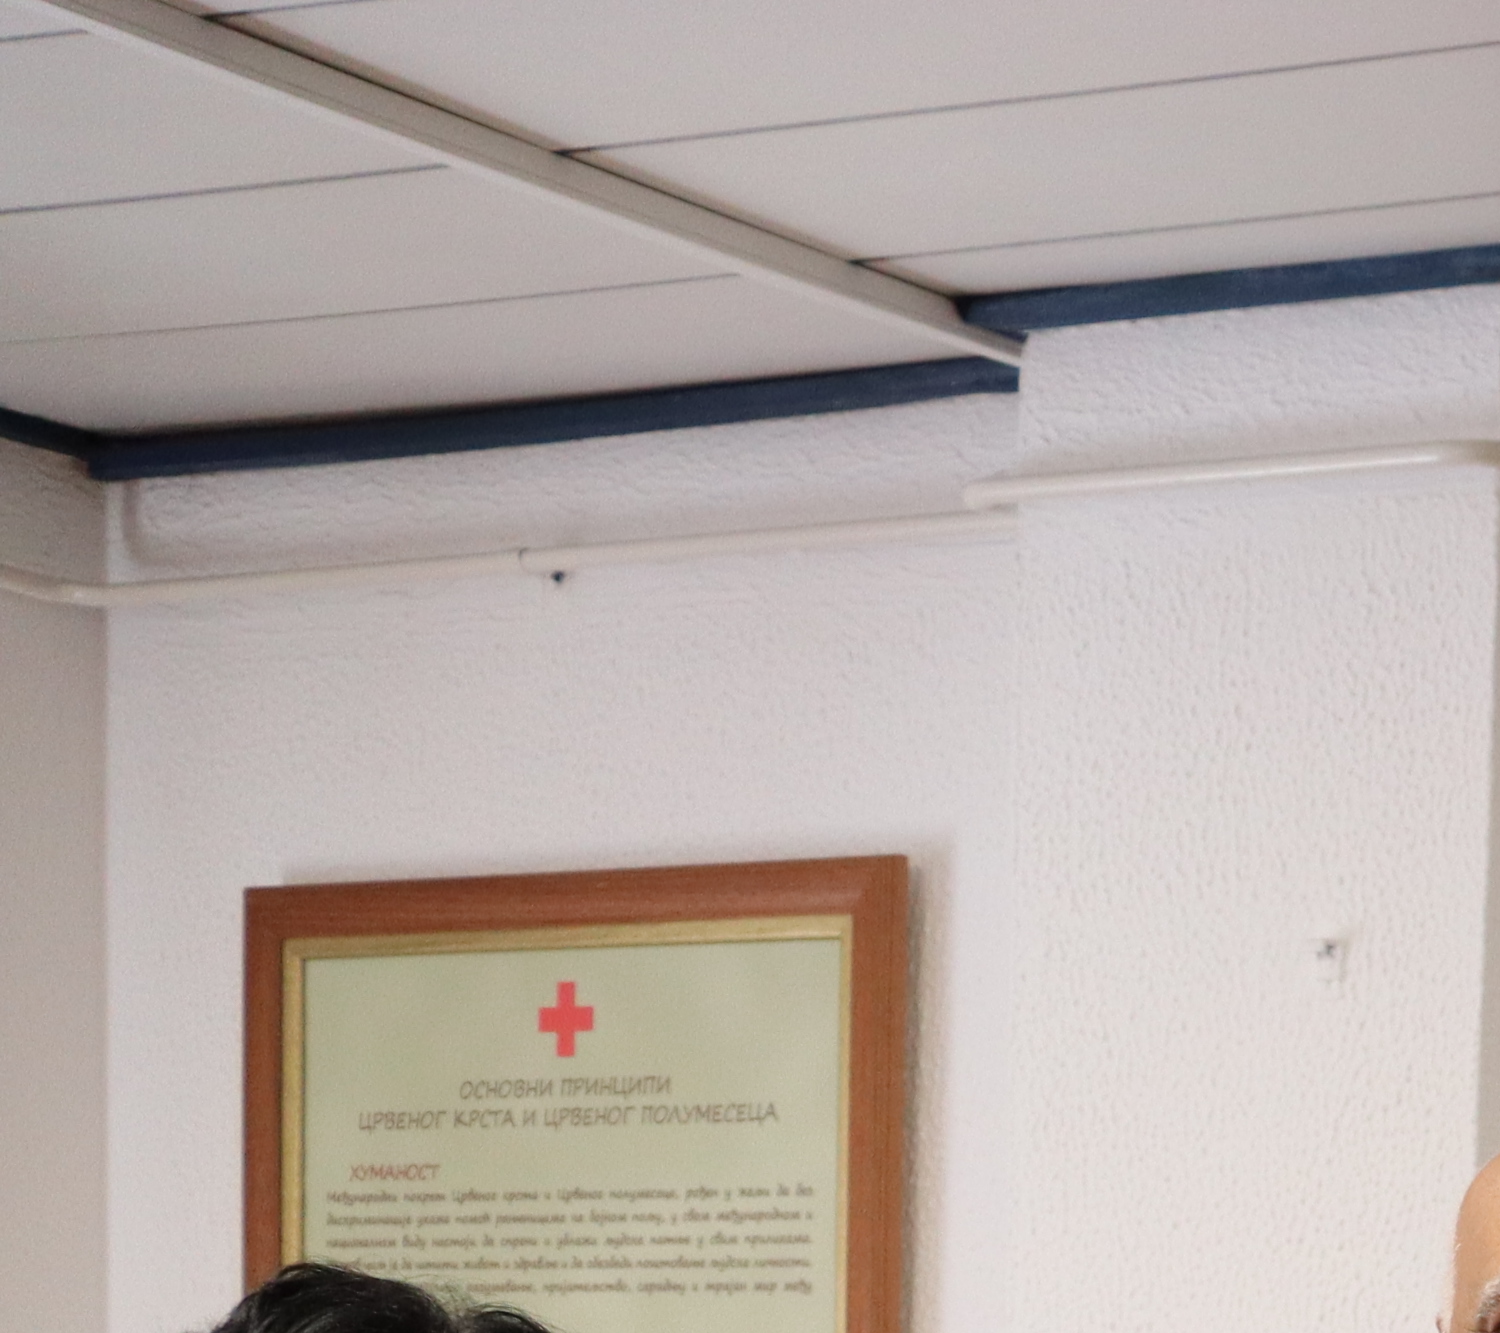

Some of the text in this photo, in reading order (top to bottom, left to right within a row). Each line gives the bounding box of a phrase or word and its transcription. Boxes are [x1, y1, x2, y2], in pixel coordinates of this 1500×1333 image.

[458, 1074, 672, 1102] ОСНОВНИ ПРИНЦИПИ
[358, 1102, 779, 1134] ЦРВЕНОГ КРСТА И ЦРВЕНОГ ПОЛУМЕСЕЦА
[350, 1163, 441, 1182] ХУМАНОСТ
